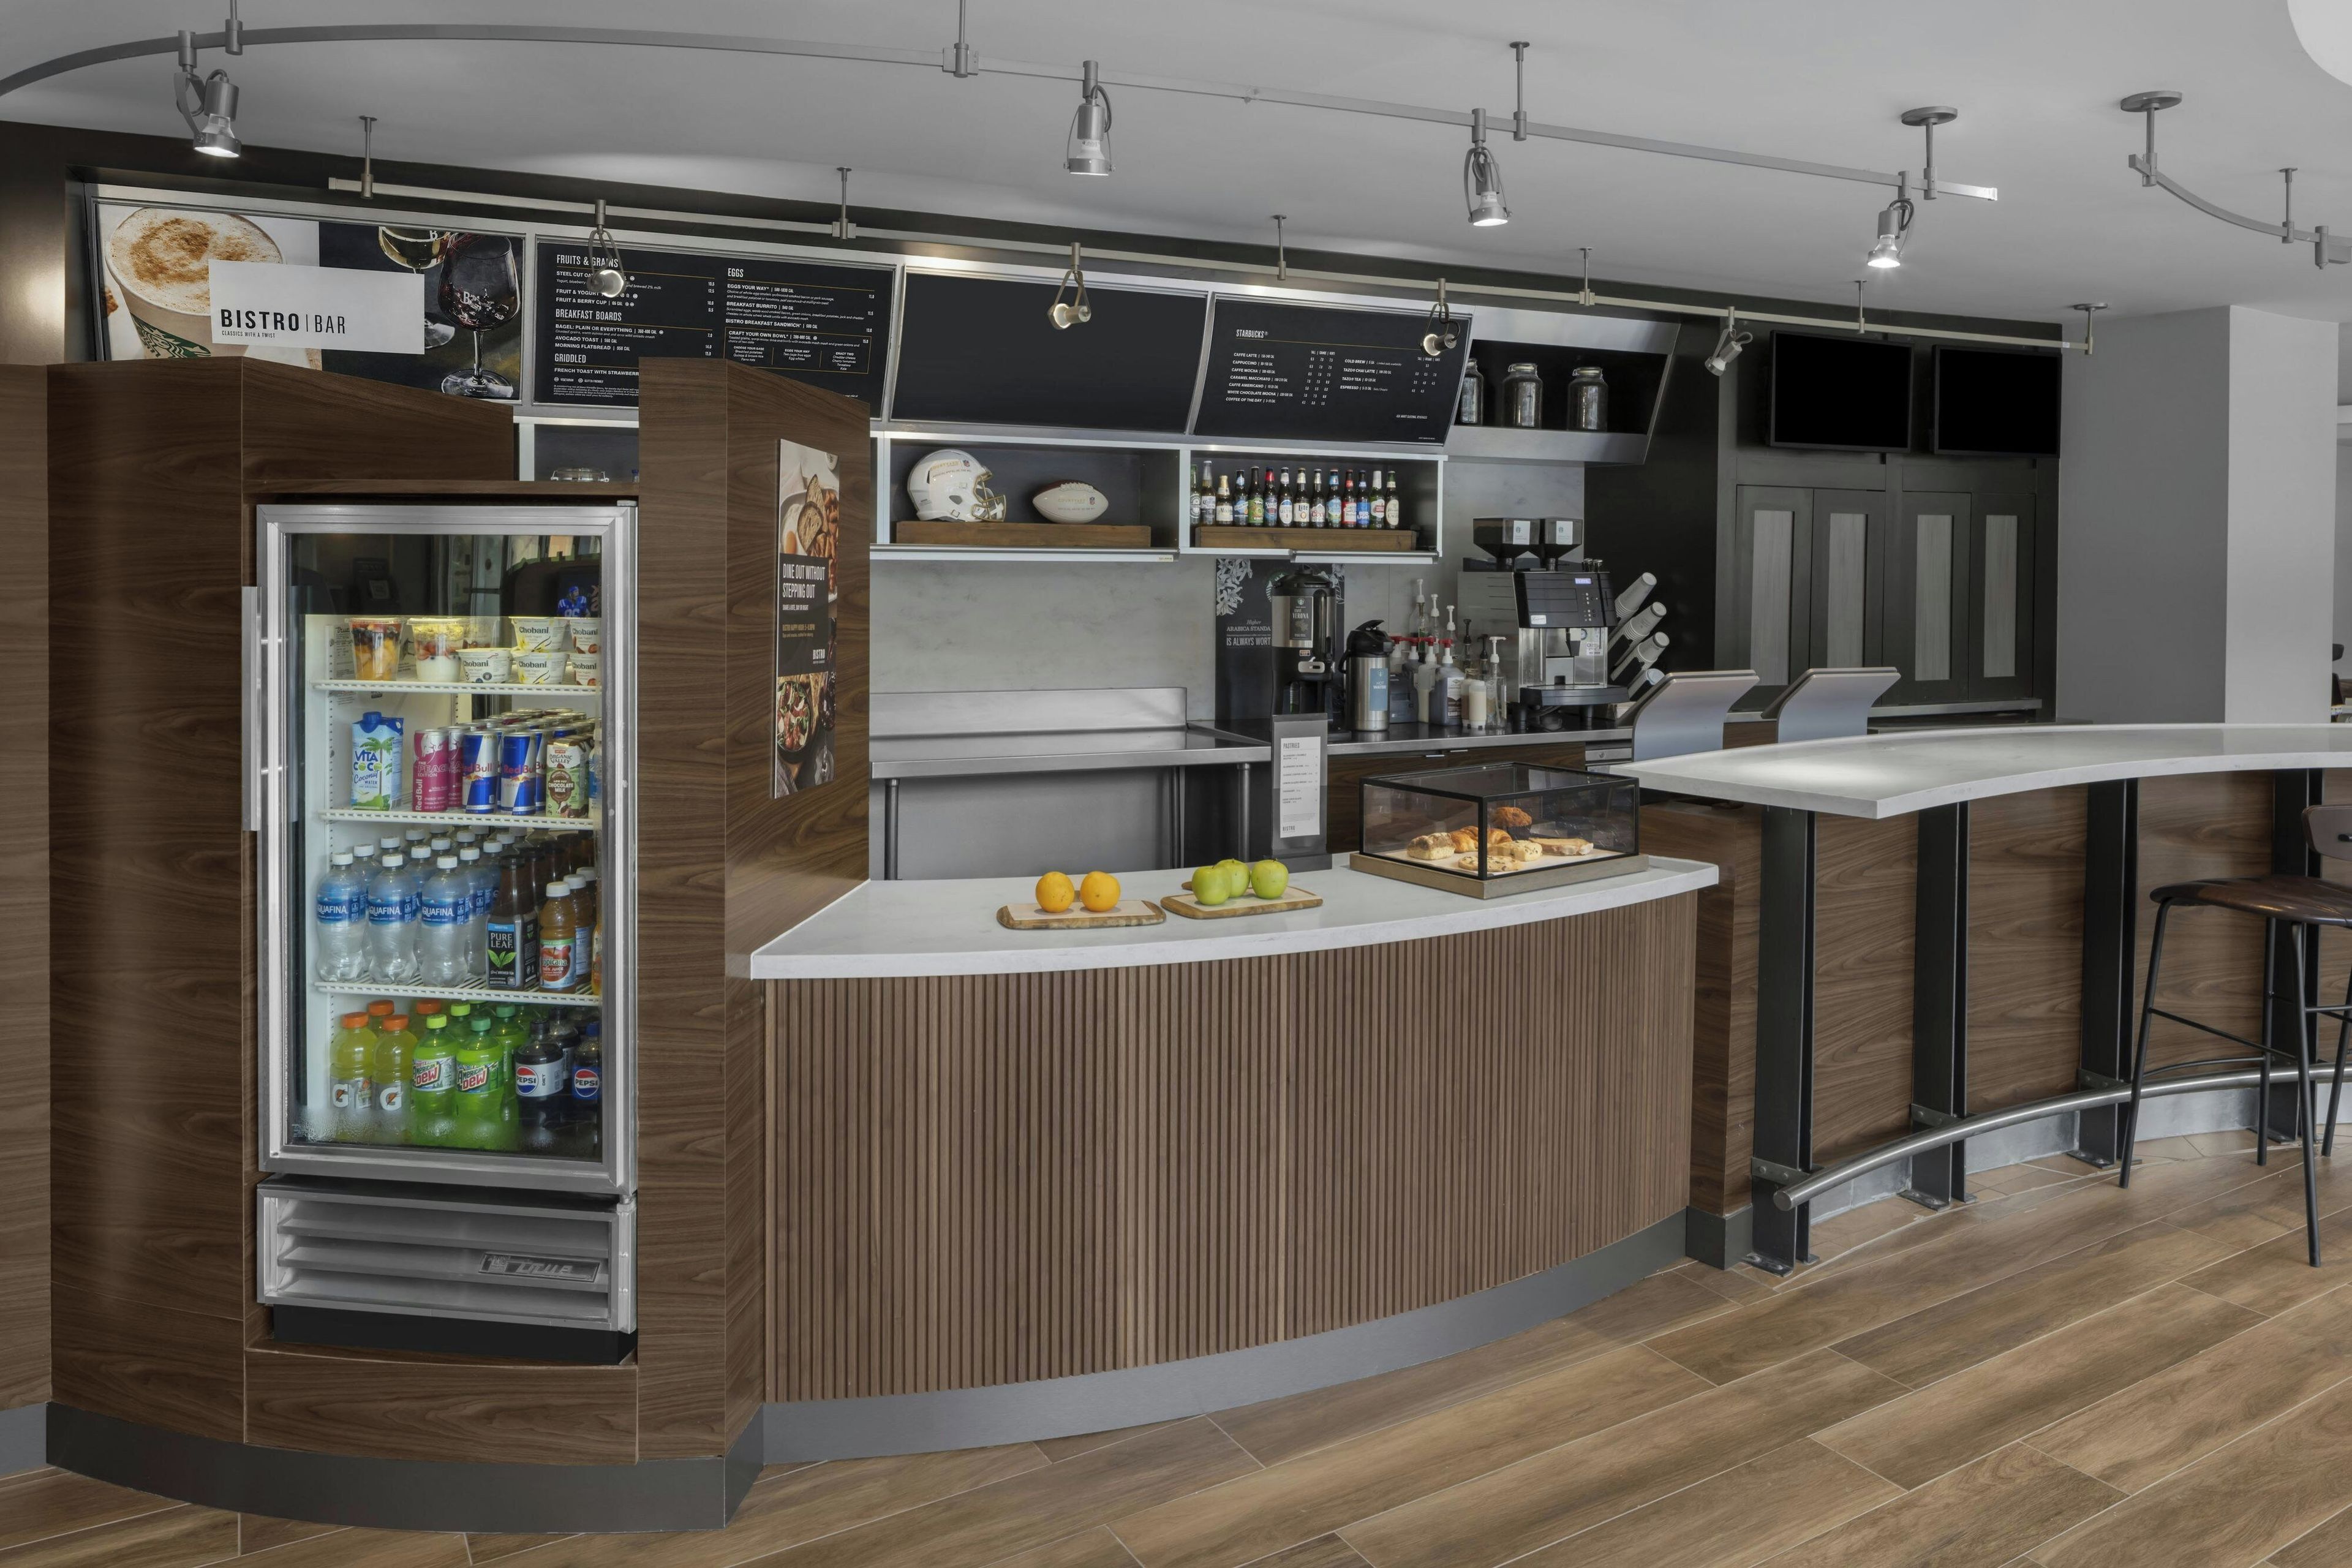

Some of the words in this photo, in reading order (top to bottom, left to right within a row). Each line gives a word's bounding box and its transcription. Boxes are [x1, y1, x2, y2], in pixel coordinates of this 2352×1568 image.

[557, 254, 581, 265] FRUITS
[583, 257, 589, 265] &
[728, 268, 744, 277] EGGS
[556, 309, 593, 320] BREAKFAST
[596, 311, 622, 322] BOARDS
[221, 309, 300, 331] BISTRO
[315, 314, 345, 334] BAR
[554, 353, 587, 363] GRIDDLED
[783, 564, 795, 579] DINE
[796, 564, 805, 579] OUT
[805, 565, 826, 581] WITHOUT
[782, 582, 805, 598] STEPPING
[806, 584, 815, 598] OUT
[1226, 637, 1232, 646] IS
[1233, 637, 1254, 646] ALWAYS
[1256, 637, 1272, 646] WORT
[813, 649, 825, 660] BISTRO
[355, 750, 379, 762] VITA
[418, 764, 447, 773] PEAC
[474, 763, 492, 772] Bull
[503, 764, 521, 774] Red
[522, 765, 534, 774] Bu
[535, 761, 547, 770] Bu
[354, 771, 379, 784] Coconut
[318, 905, 349, 915] QUAFINA
[491, 932, 513, 941] PURE
[491, 940, 513, 949] LEAF.
